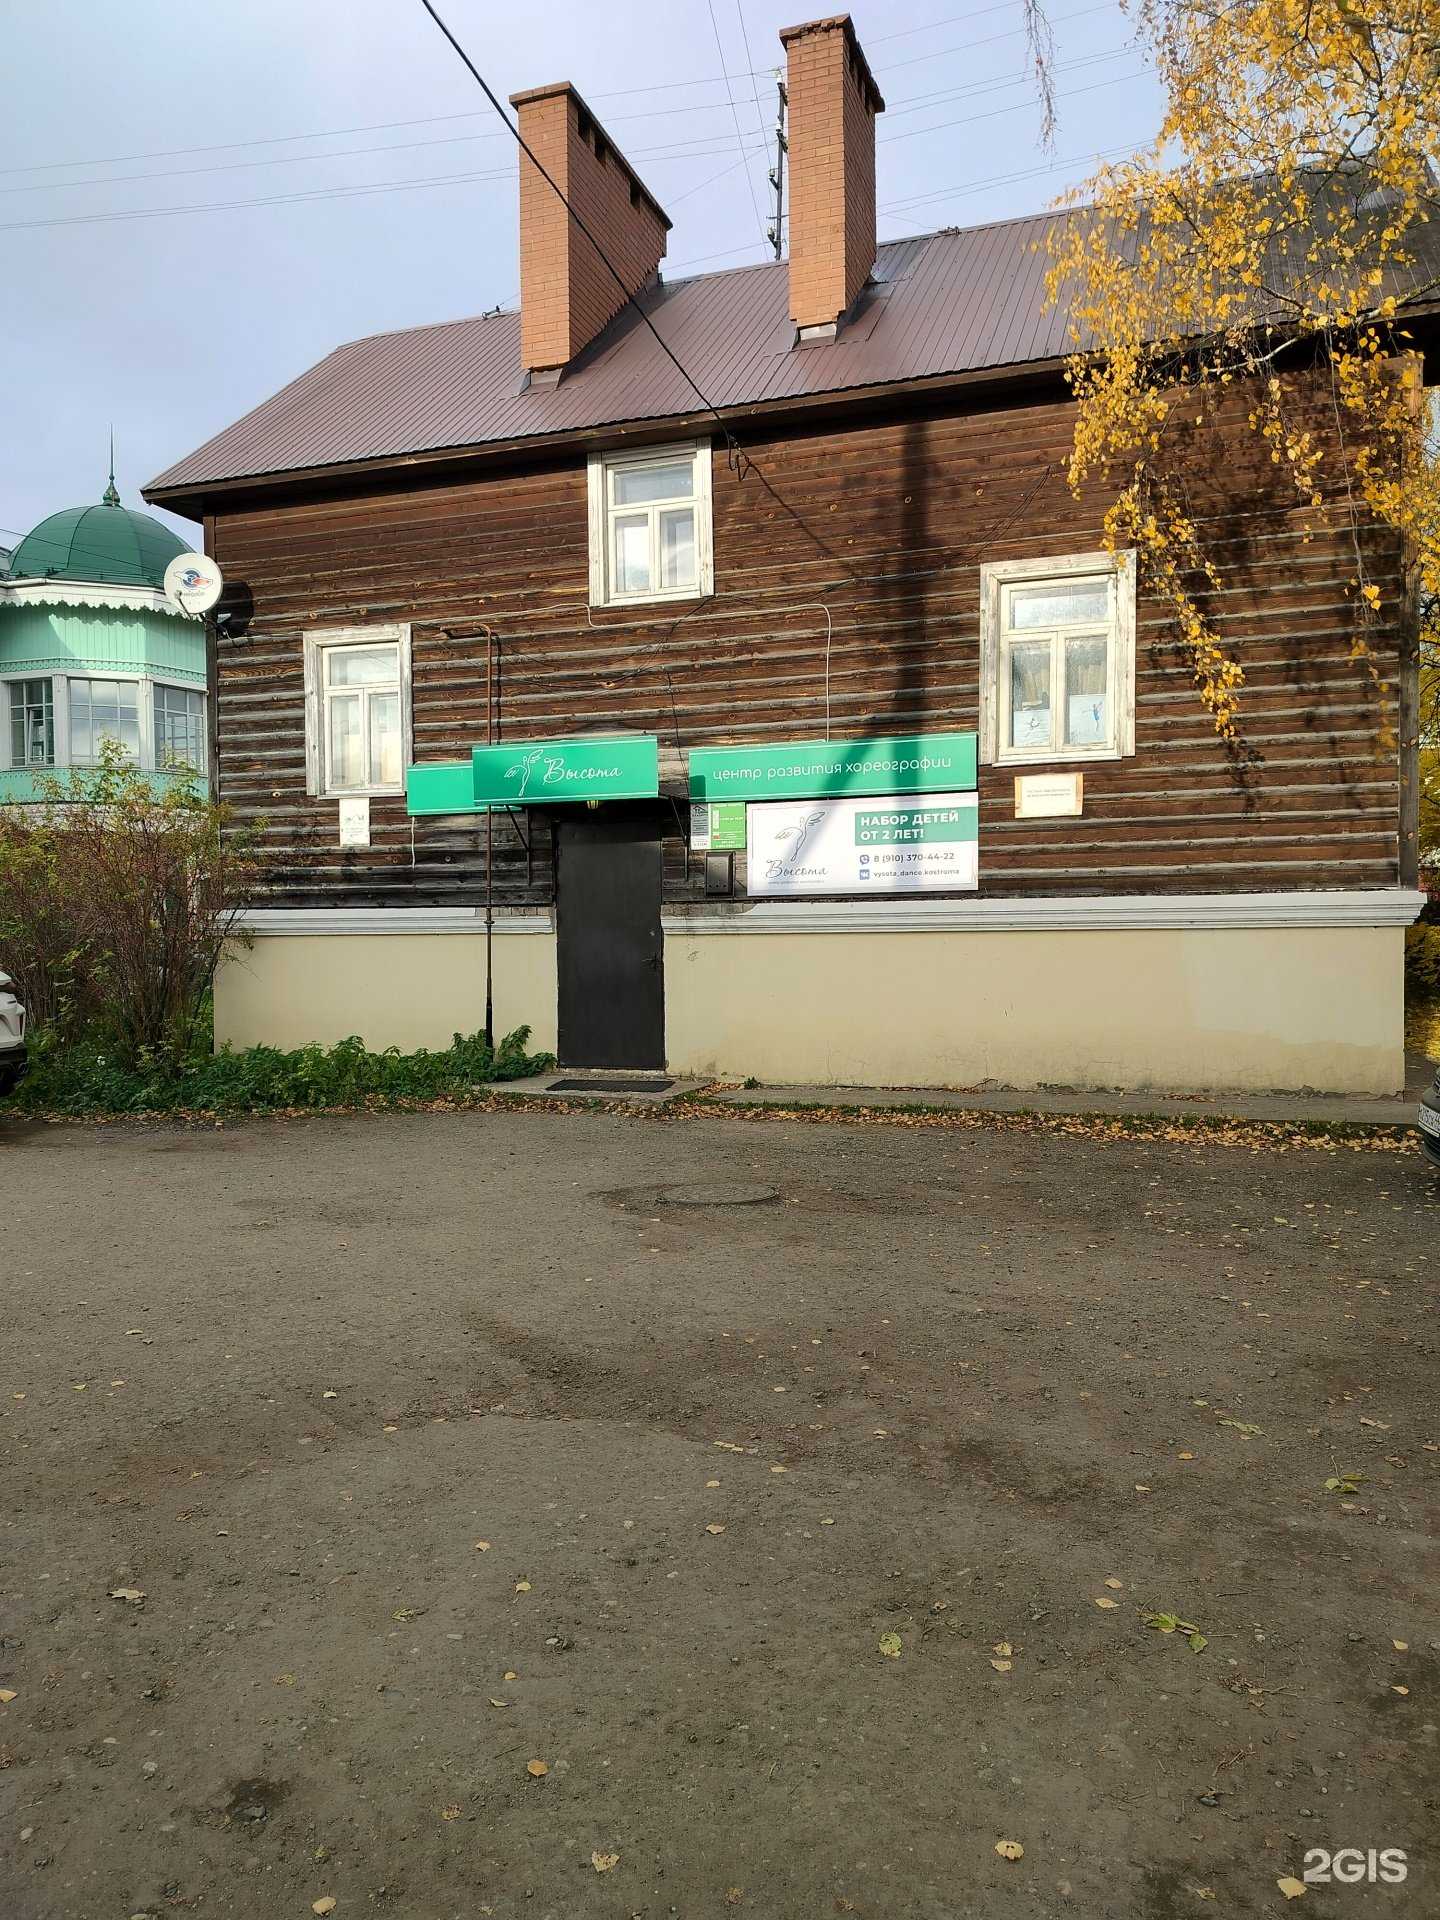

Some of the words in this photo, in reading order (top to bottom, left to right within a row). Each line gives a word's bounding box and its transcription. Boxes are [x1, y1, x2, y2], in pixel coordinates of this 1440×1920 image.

[543, 757, 623, 785] Высота
[713, 768, 762, 783] центр
[767, 763, 843, 781] развития
[845, 755, 952, 775] хореографии
[861, 814, 909, 826] НАБОР
[912, 810, 960, 826] ДЕТЕЙ
[860, 830, 879, 841] ОТ
[882, 830, 891, 840] 2
[893, 828, 924, 840] ЛЕТ!
[882, 854, 904, 863] (910)
[906, 852, 955, 862] 370-44-22
[765, 859, 828, 878] Высота
